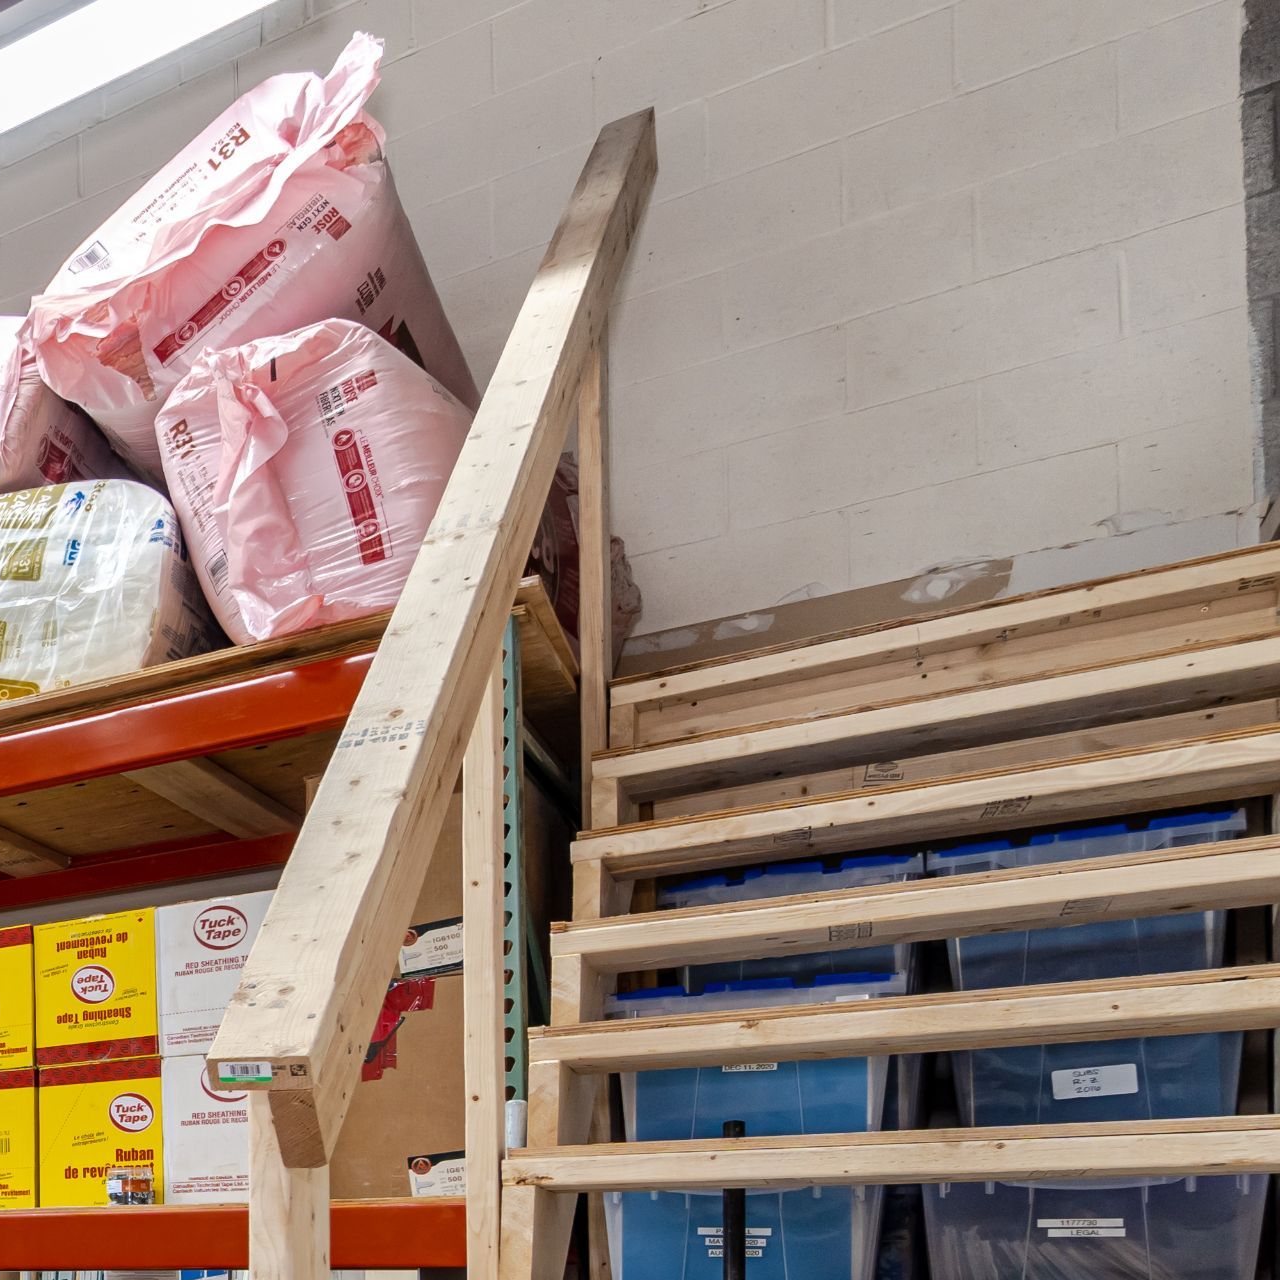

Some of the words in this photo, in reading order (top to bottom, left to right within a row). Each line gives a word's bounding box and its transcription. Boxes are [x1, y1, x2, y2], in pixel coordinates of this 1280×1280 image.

[207, 127, 251, 172] R31
[313, 207, 340, 236] ROSE
[199, 915, 236, 930] Tuck
[115, 931, 129, 943] de
[205, 928, 242, 941] Tape
[56, 936, 113, 953] revêtement
[76, 946, 107, 960] Ruban
[185, 961, 199, 970] RED
[201, 956, 240, 967] SHEATHING
[174, 969, 194, 977] RUBAN
[194, 967, 215, 976] ROUGE
[76, 974, 106, 985] Tape
[80, 983, 109, 995] Tuck
[56, 1013, 80, 1025] Tape
[82, 1006, 132, 1022] Sheathing
[755, 1063, 775, 1071] 2020
[114, 1103, 146, 1114] Tuck
[207, 1109, 247, 1118] SHEATHING
[117, 1113, 148, 1125] Tape
[180, 1119, 200, 1127] RUBAN
[115, 1148, 155, 1163] Ruban
[64, 1165, 79, 1180] de
[1070, 1228, 1101, 1237] LEGAL
